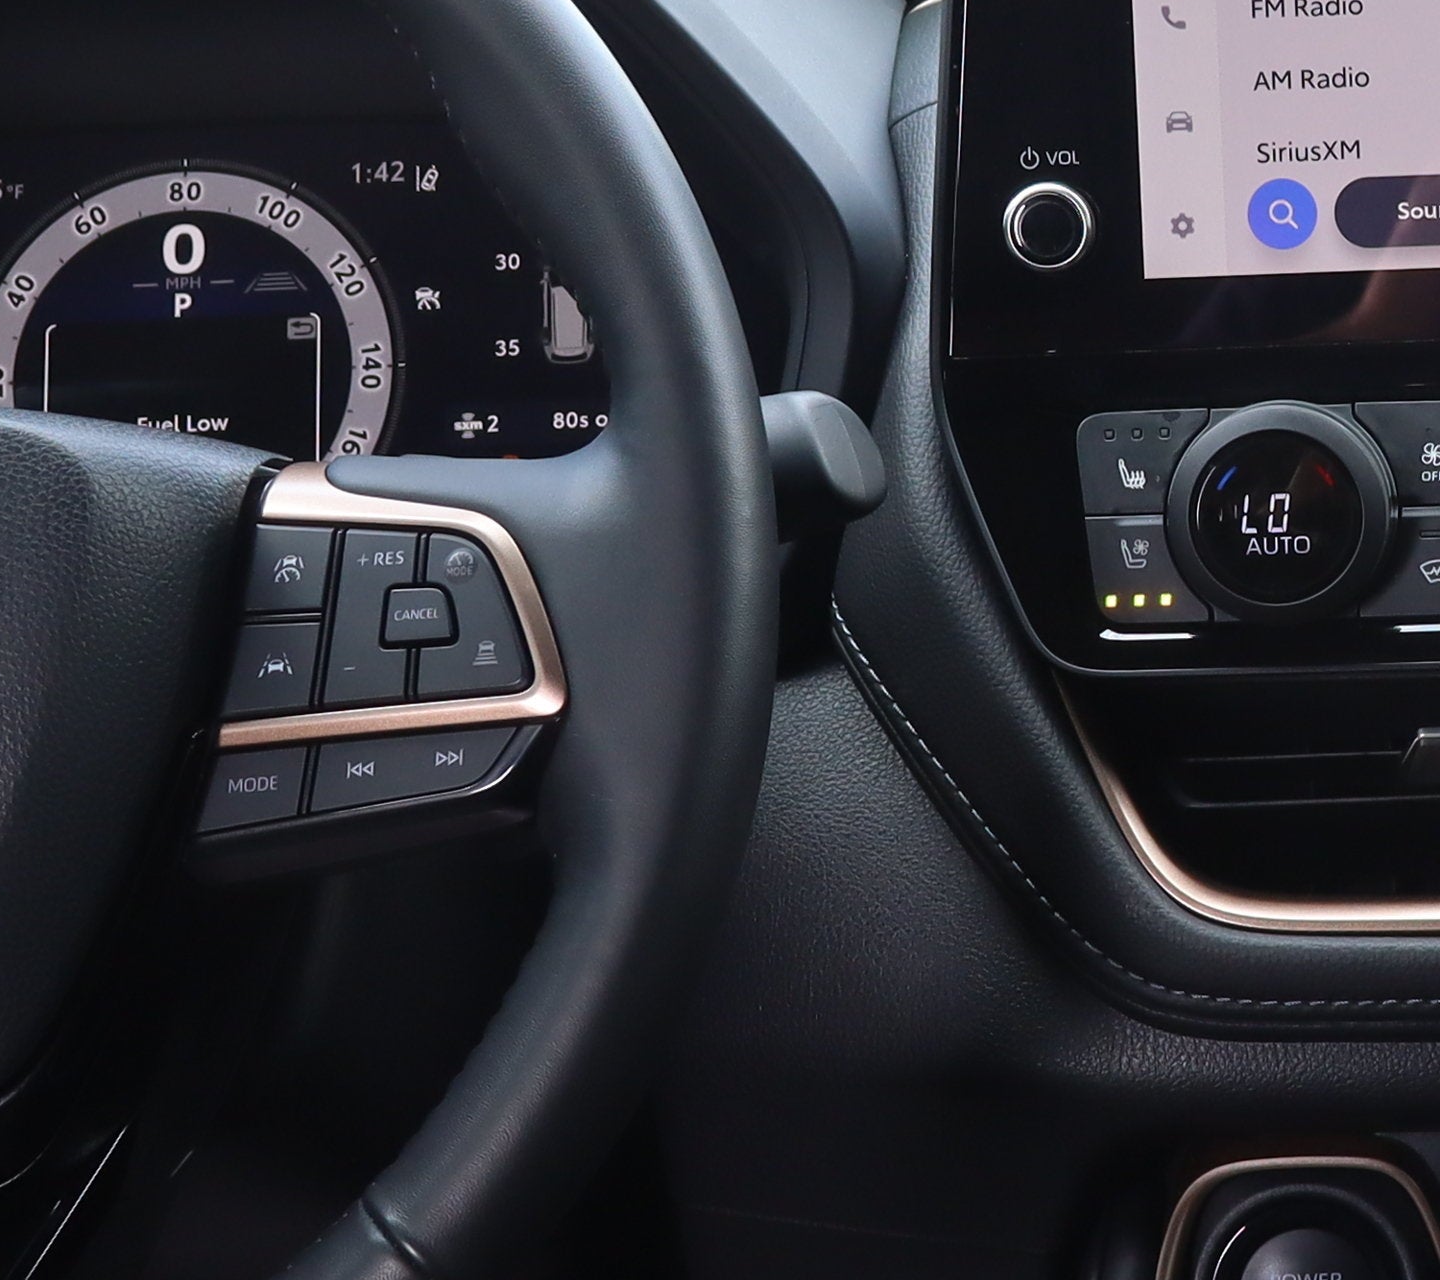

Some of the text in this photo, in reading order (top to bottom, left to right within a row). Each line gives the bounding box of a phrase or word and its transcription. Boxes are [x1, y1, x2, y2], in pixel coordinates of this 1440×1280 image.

[1253, 65, 1370, 93] AM Radio
[1045, 150, 1080, 166] VOL
[1256, 138, 1362, 166] SiriusXM
[351, 161, 405, 184] 1:42
[168, 180, 202, 202] 80
[72, 205, 108, 236] 60
[255, 193, 302, 230] 100
[162, 222, 206, 275] 0
[494, 253, 521, 271] 30
[165, 275, 202, 290] MPH
[326, 251, 365, 298] 120
[6, 273, 36, 310] 40
[173, 292, 193, 318] P
[494, 339, 520, 357] 35
[359, 343, 382, 390] 140
[186, 414, 229, 432] Low
[487, 415, 499, 433] 2
[552, 411, 608, 429] 80s o
[341, 429, 368, 455] 16
[1241, 492, 1290, 535] LO
[1245, 535, 1311, 556] AUTO
[372, 551, 405, 567] RES
[446, 566, 473, 577] MODE
[393, 607, 439, 622] CANCEL
[227, 775, 279, 795] MODE
